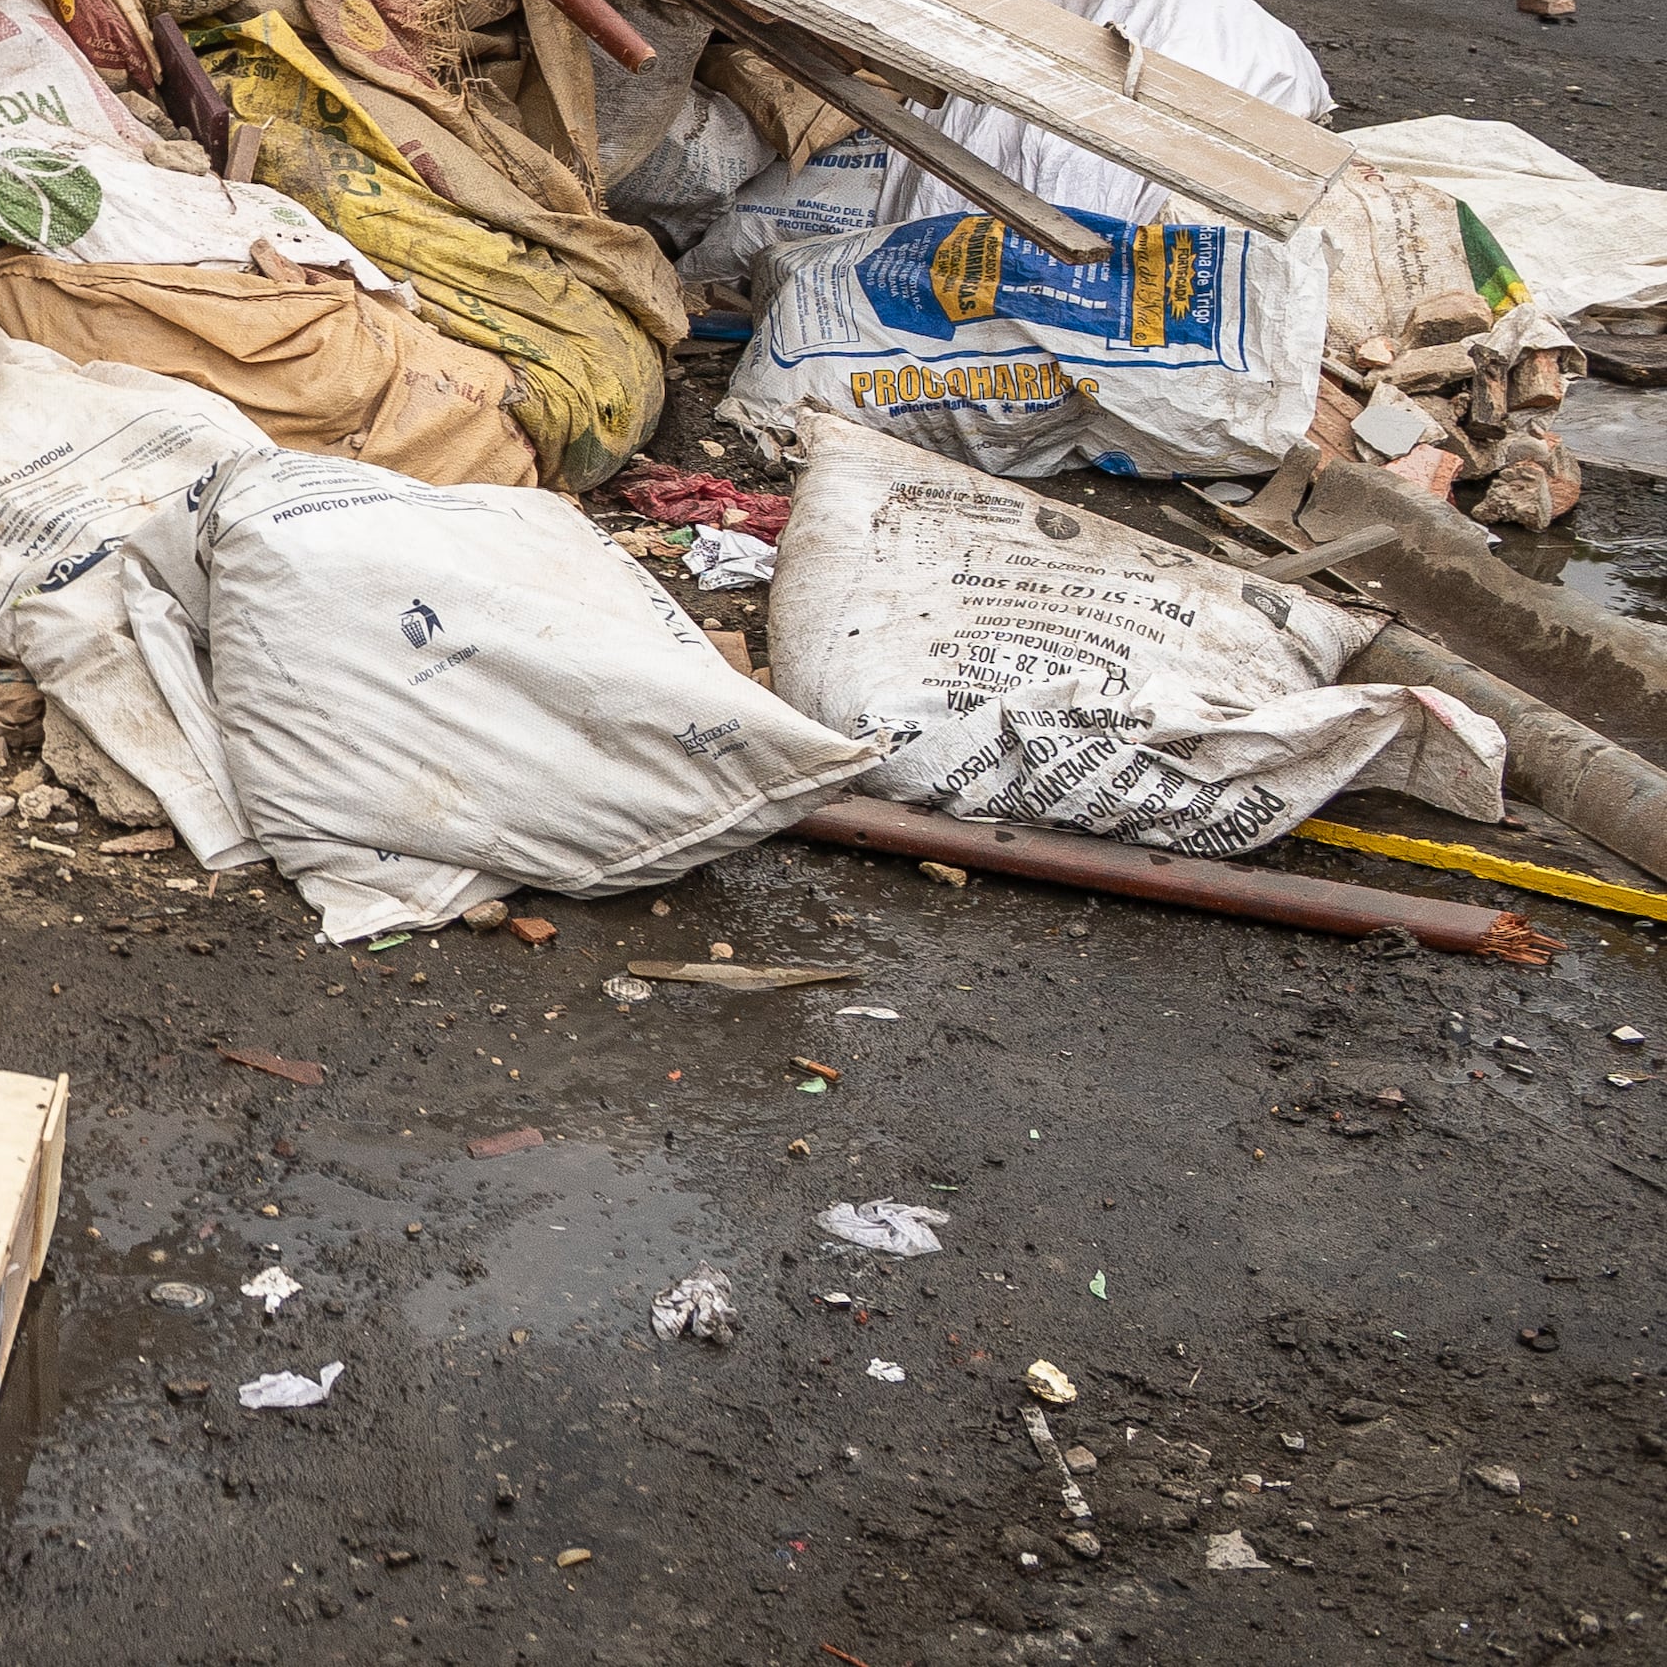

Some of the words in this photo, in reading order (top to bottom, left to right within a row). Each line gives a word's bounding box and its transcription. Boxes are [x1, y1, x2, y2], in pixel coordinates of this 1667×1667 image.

[1197, 269, 1213, 287] de
[1193, 291, 1213, 324] Trigo
[9, 440, 73, 483] PRODUCTO
[271, 496, 349, 524] PRODUCTO
[351, 492, 396, 508] PERUA
[950, 573, 1009, 589] 3000
[1101, 589, 1128, 604] 57
[961, 596, 1068, 615] COLOMBIANA
[974, 615, 1130, 660] www.incauca.com
[1075, 604, 1164, 644] INDUSTRIA
[928, 640, 959, 657] Cali
[954, 629, 1117, 672] auca@incauca.com
[1015, 654, 1036, 674] 28
[407, 665, 435, 686] LADO
[446, 644, 479, 668] ESTIBA
[957, 662, 1022, 688] OFICINA
[686, 718, 740, 750] NORSAC
